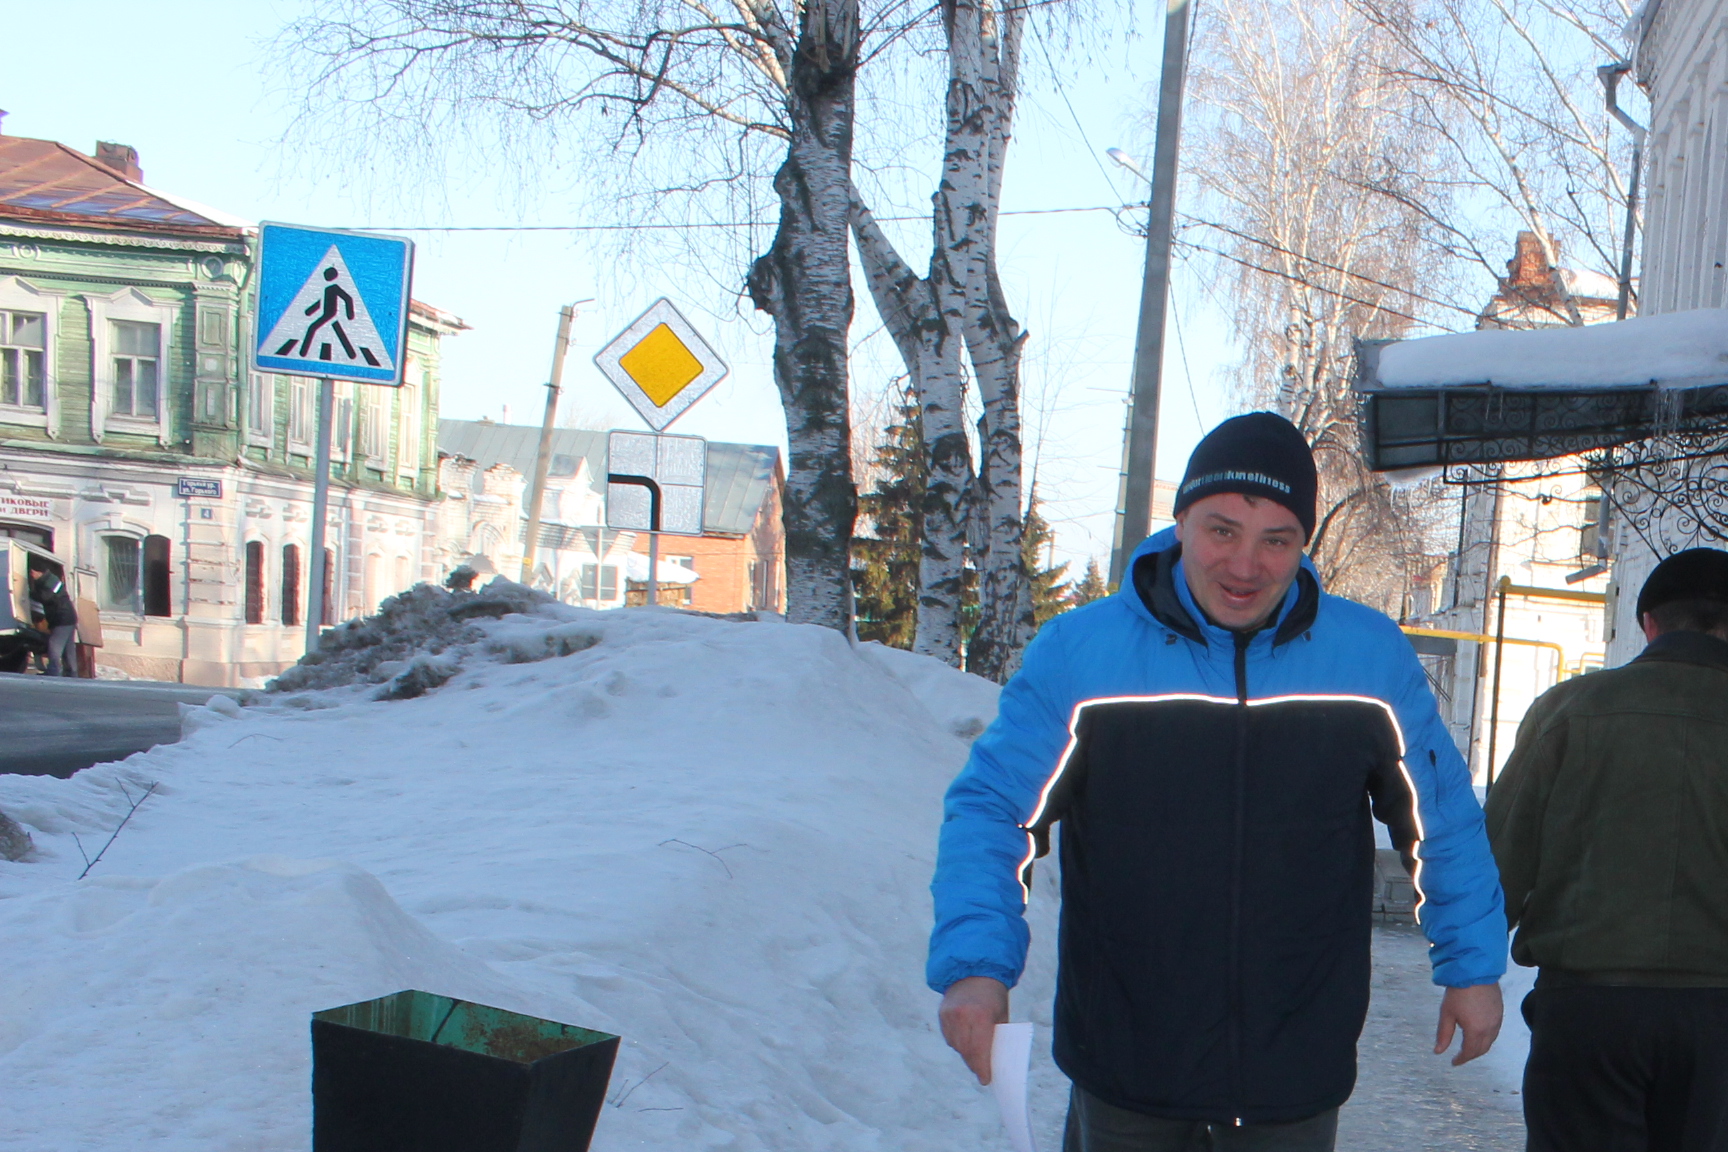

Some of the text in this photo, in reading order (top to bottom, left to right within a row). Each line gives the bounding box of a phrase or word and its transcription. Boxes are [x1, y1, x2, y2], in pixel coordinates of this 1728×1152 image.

[0, 497, 49, 507] ИКОВЫЕ
[10, 507, 48, 516] ДВЕРИ
[203, 509, 210, 518] 4
